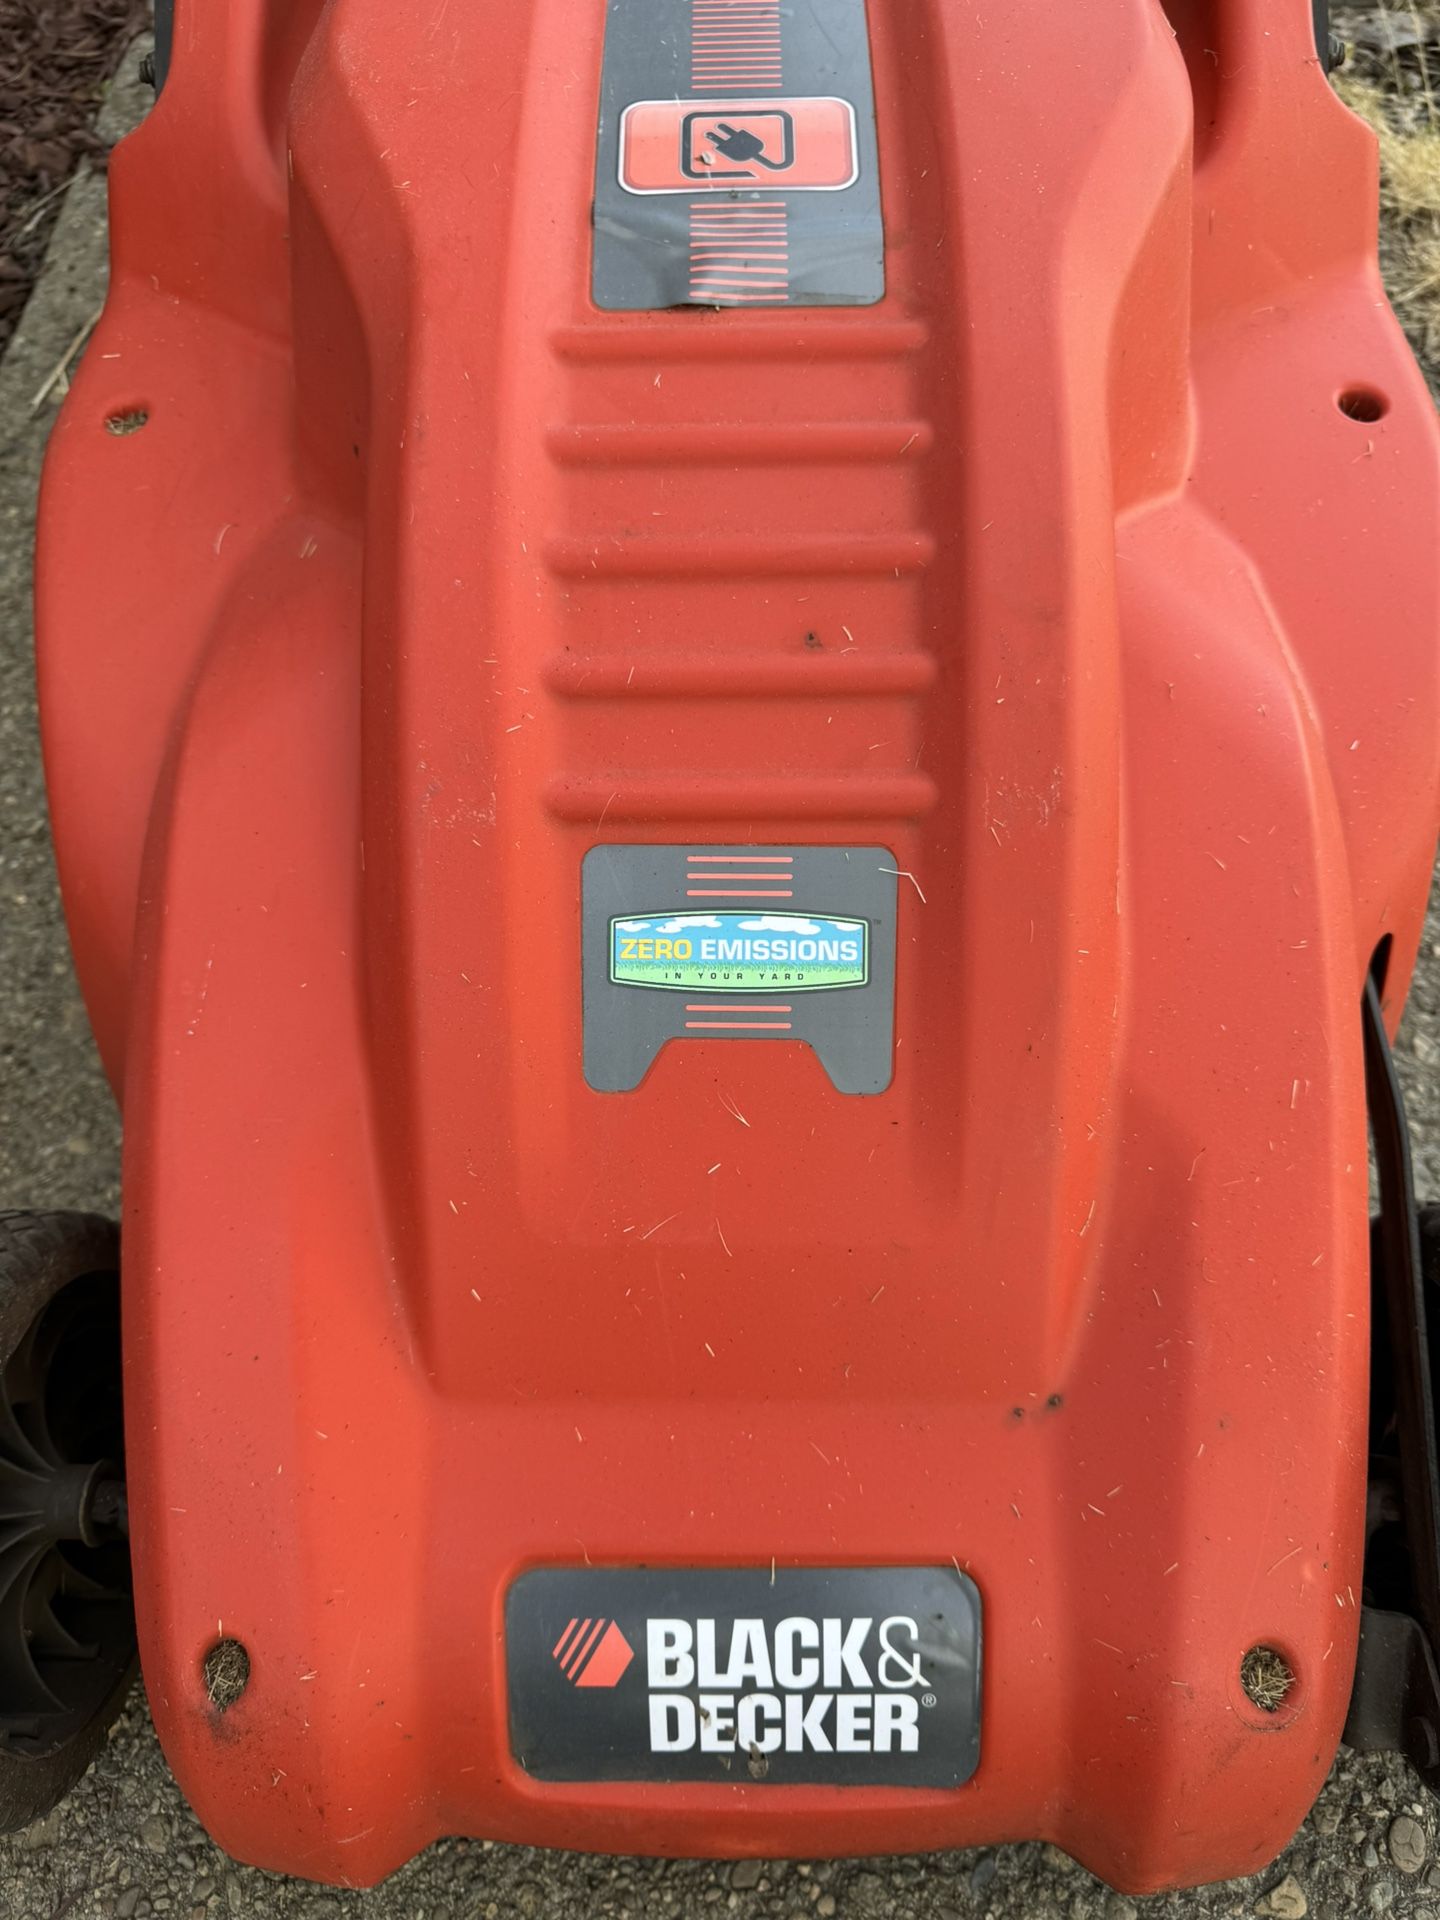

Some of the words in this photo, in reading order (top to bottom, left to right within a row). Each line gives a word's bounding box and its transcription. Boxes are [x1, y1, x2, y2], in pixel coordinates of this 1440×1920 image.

[620, 939, 692, 960] ZERO
[701, 939, 858, 961] EMISSIONS
[664, 972, 682, 980] IN
[698, 972, 744, 980] YOUR
[759, 973, 805, 981] YARD
